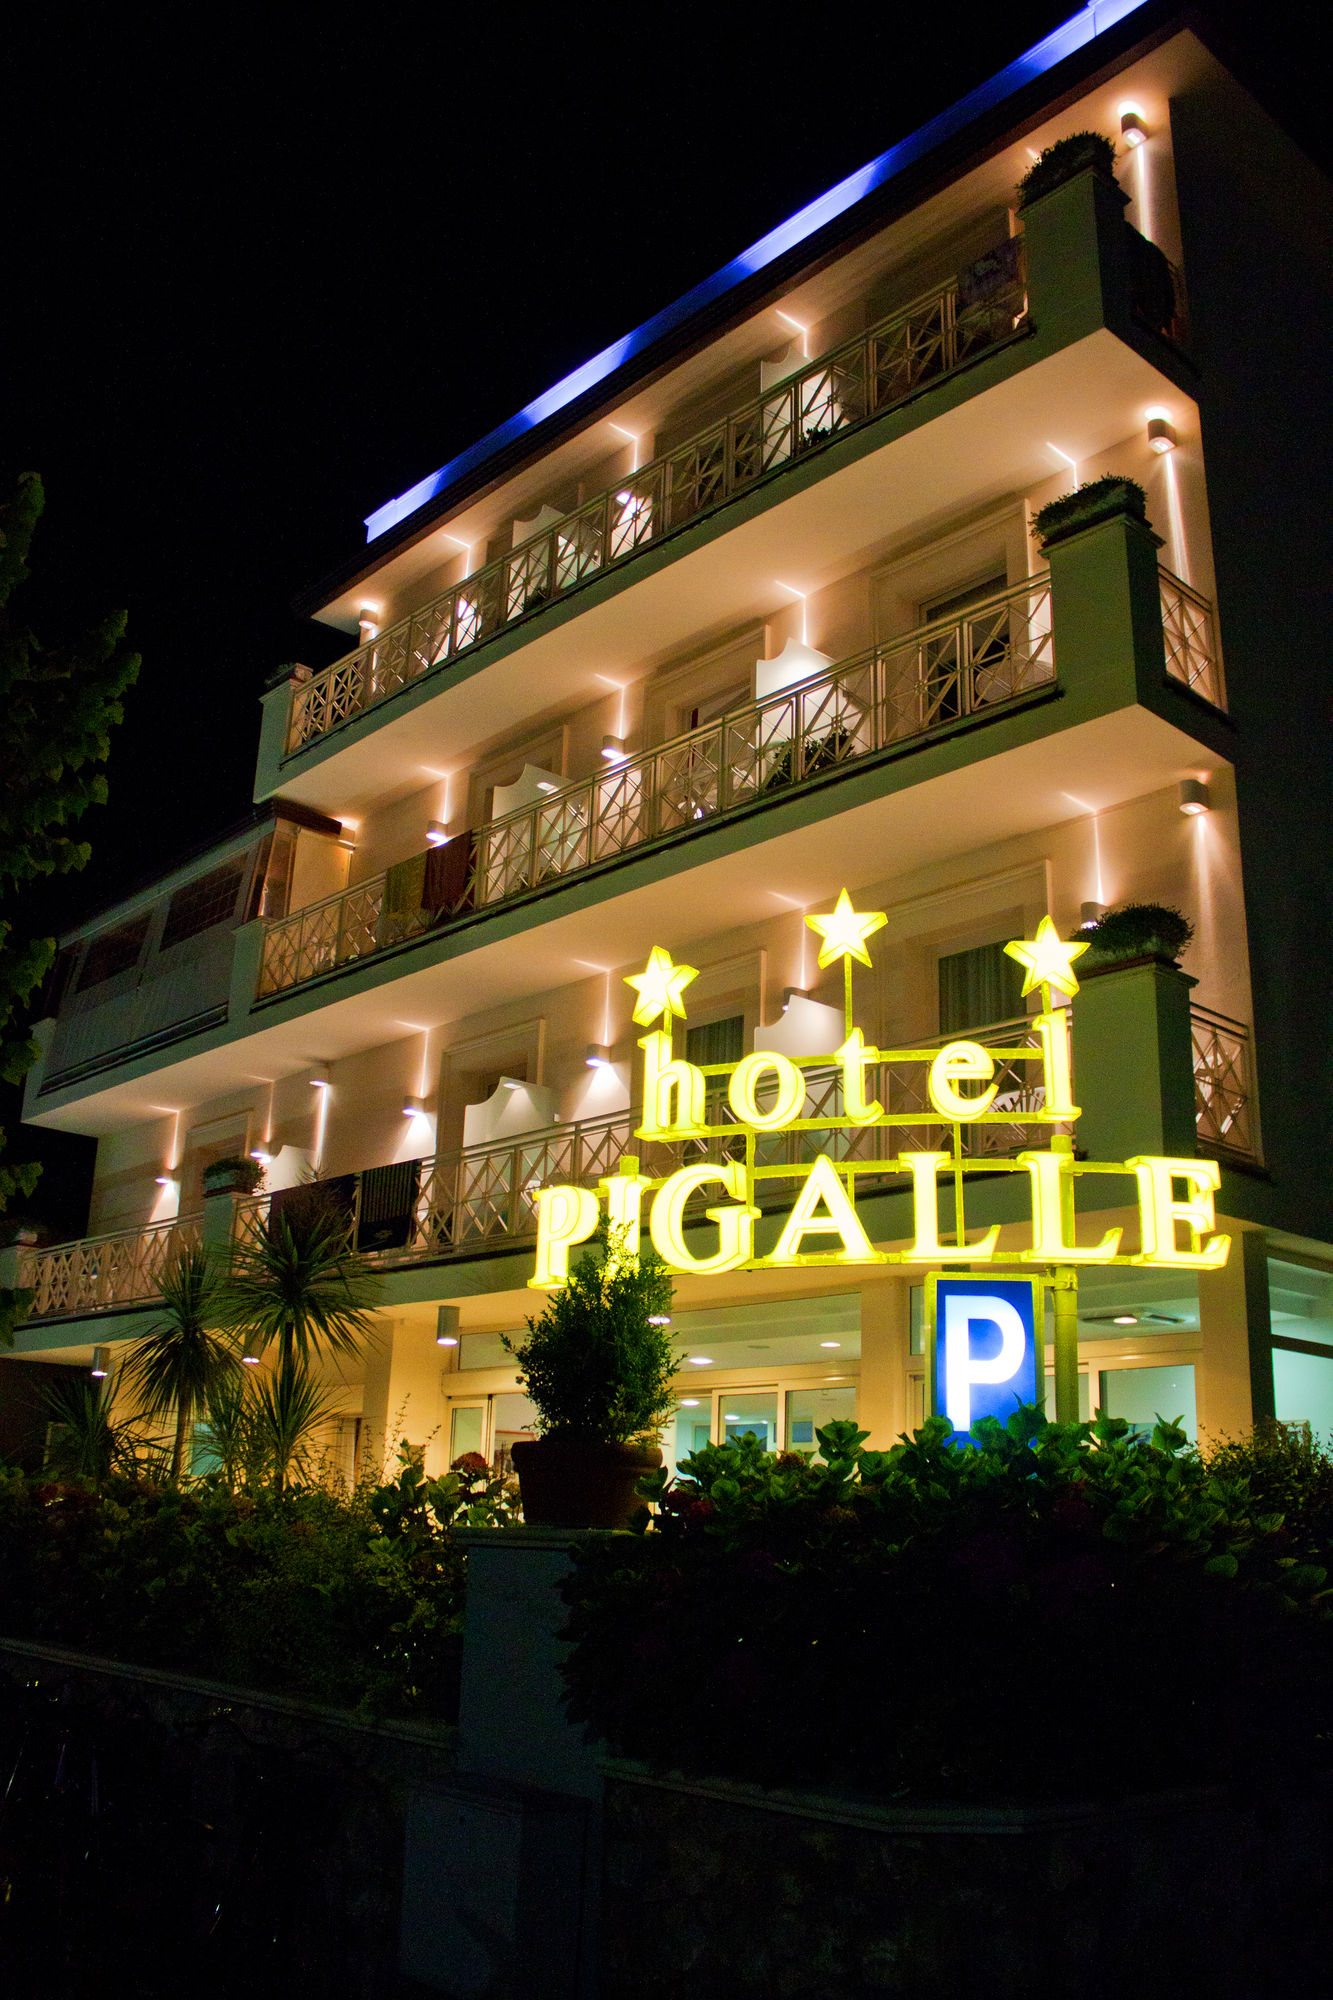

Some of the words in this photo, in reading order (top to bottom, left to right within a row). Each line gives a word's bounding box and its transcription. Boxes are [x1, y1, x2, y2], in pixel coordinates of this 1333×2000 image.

[634, 1010, 1082, 1142] hotel
[528, 1151, 1231, 1289] PIGALLE
[944, 1294, 1027, 1433] P
